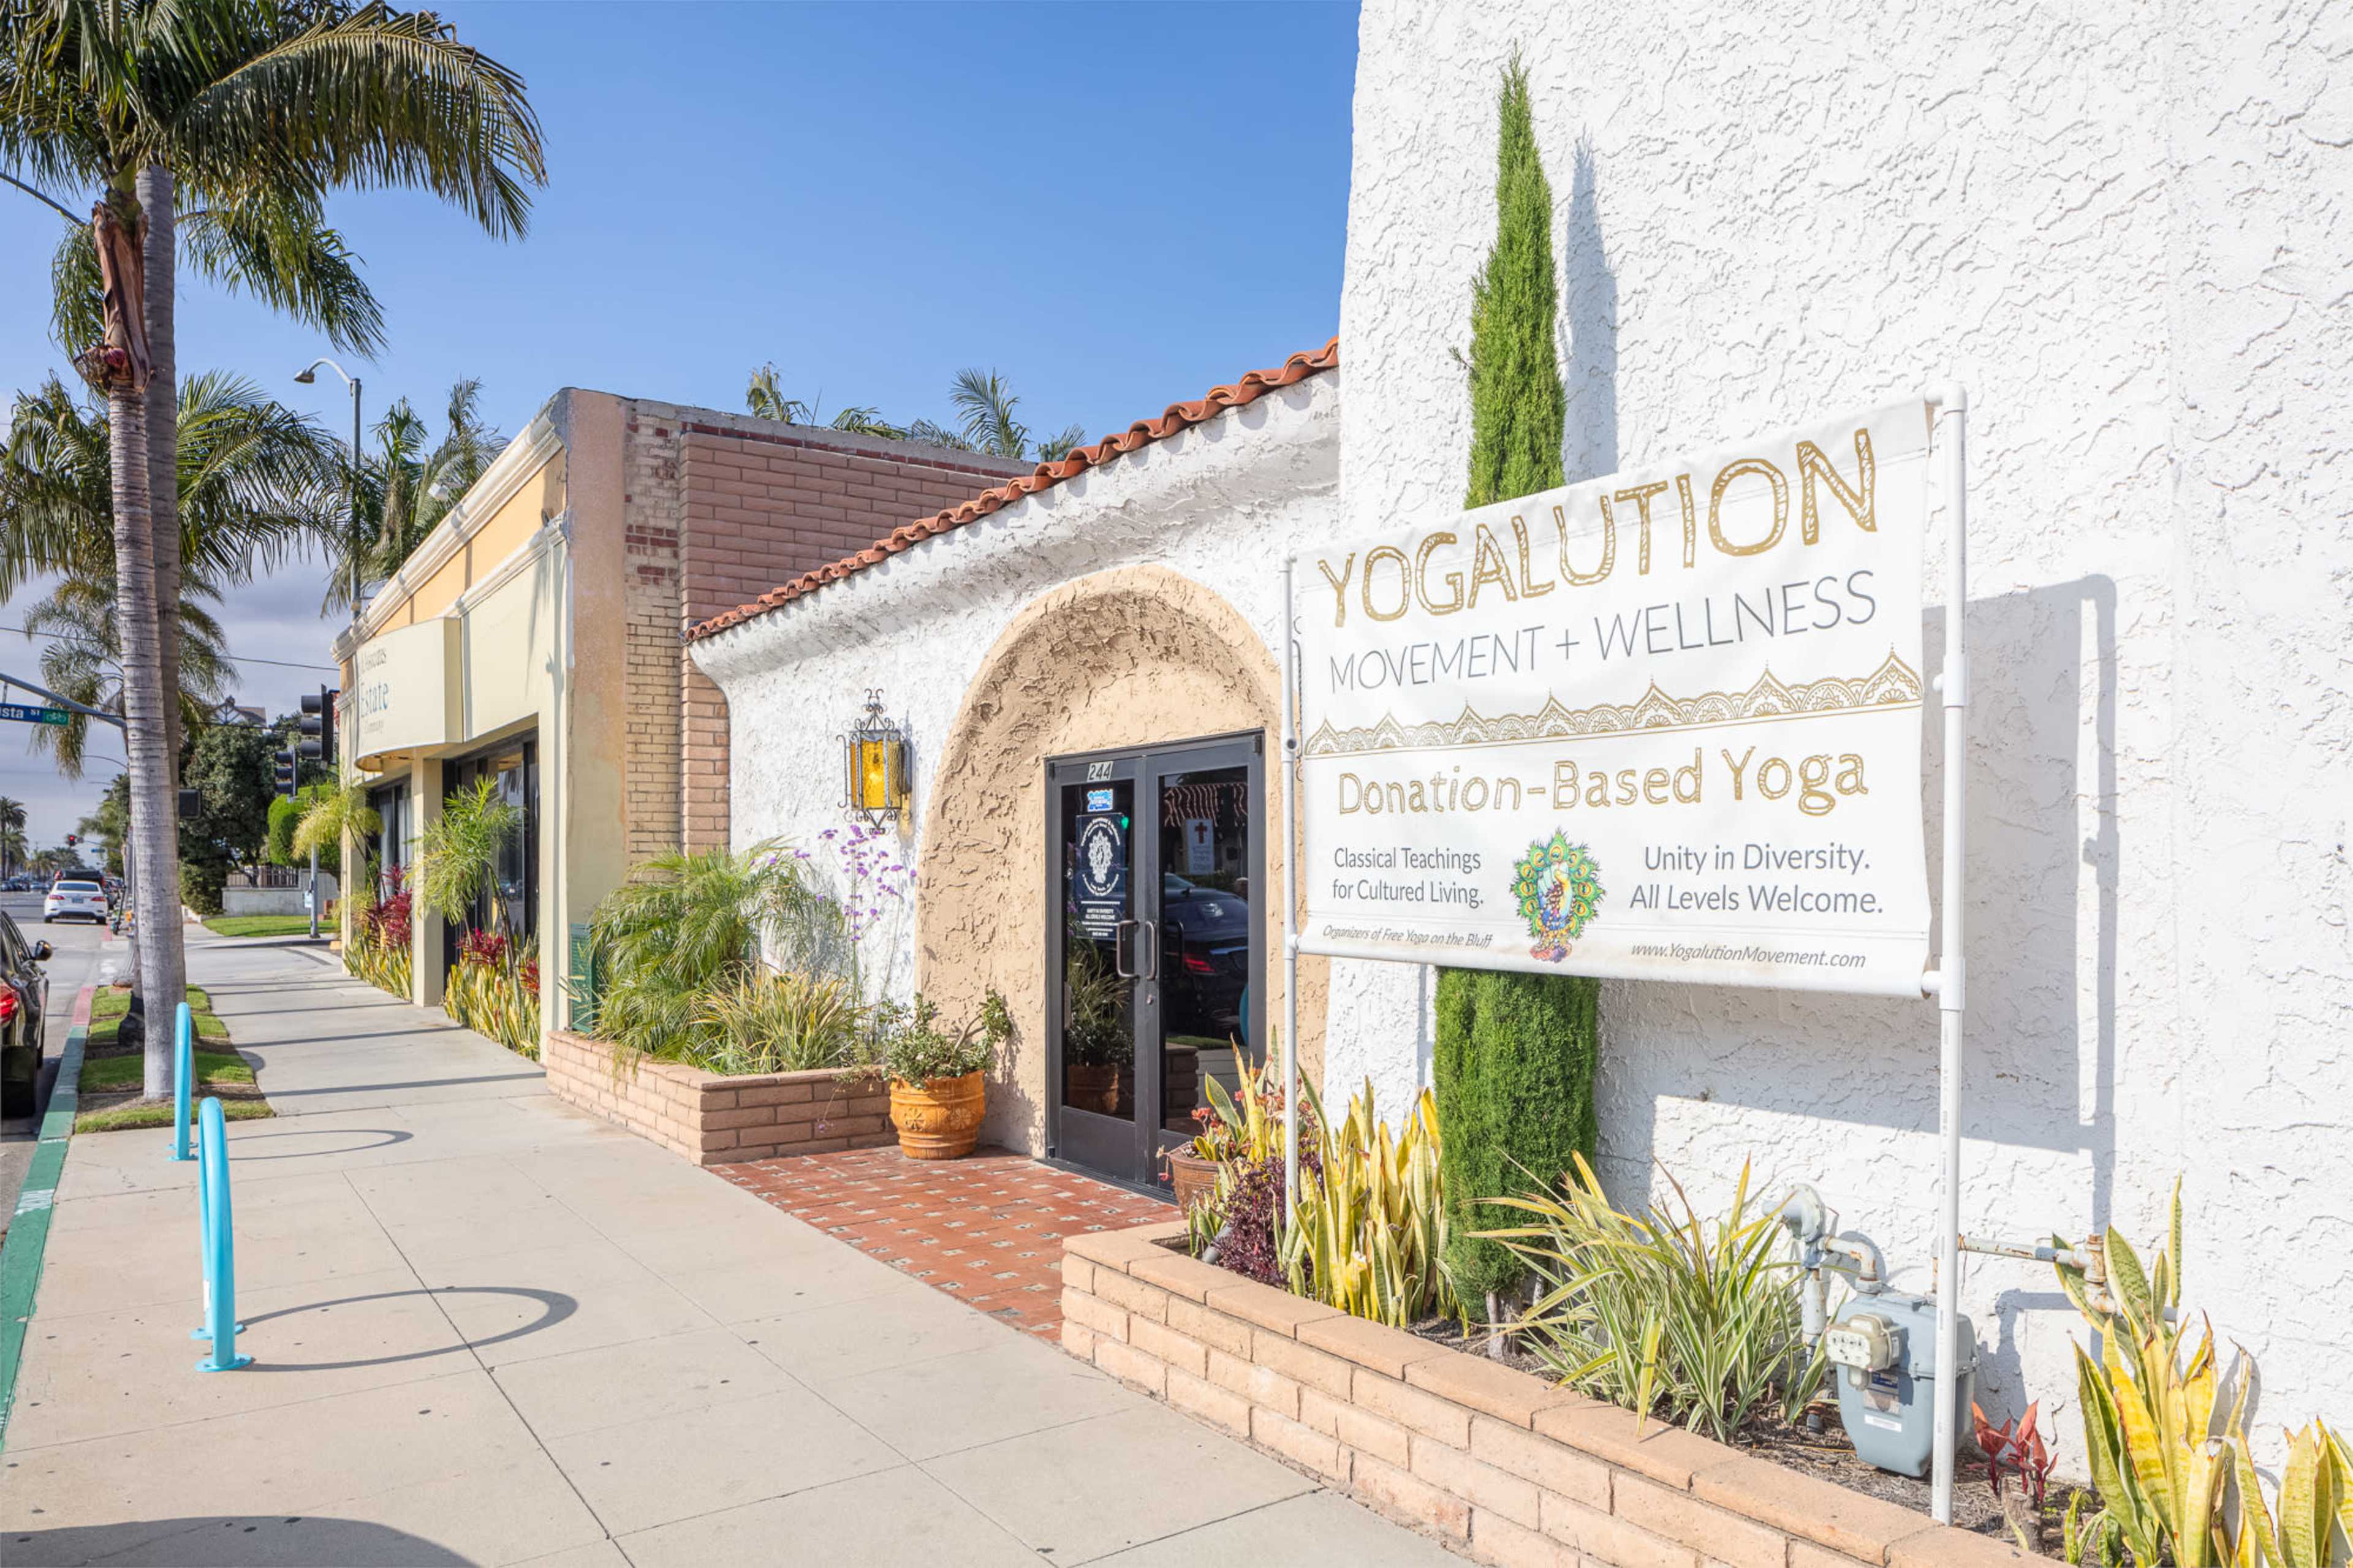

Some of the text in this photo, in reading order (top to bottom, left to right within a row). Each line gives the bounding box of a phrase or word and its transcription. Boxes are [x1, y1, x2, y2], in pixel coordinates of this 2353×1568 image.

[1317, 427, 1879, 627] YOGALUTION
[1330, 570, 1876, 694] MOVEMENT + WELLNESS
[360, 681, 388, 718] Estate
[1089, 763, 1112, 781] 244
[1338, 746, 1869, 817] Donation-Based Yoga
[1335, 847, 1482, 875] Classical Teachings
[1645, 841, 1870, 876] Unity in Diversity.
[1333, 878, 1485, 910] for Cultured Living.
[1629, 884, 1883, 914] All Levels Welcome.
[1323, 925, 1494, 949] Organizers of Free Yoga on the Bluff
[1631, 943, 1866, 968] www.YogalutionMovement.com
